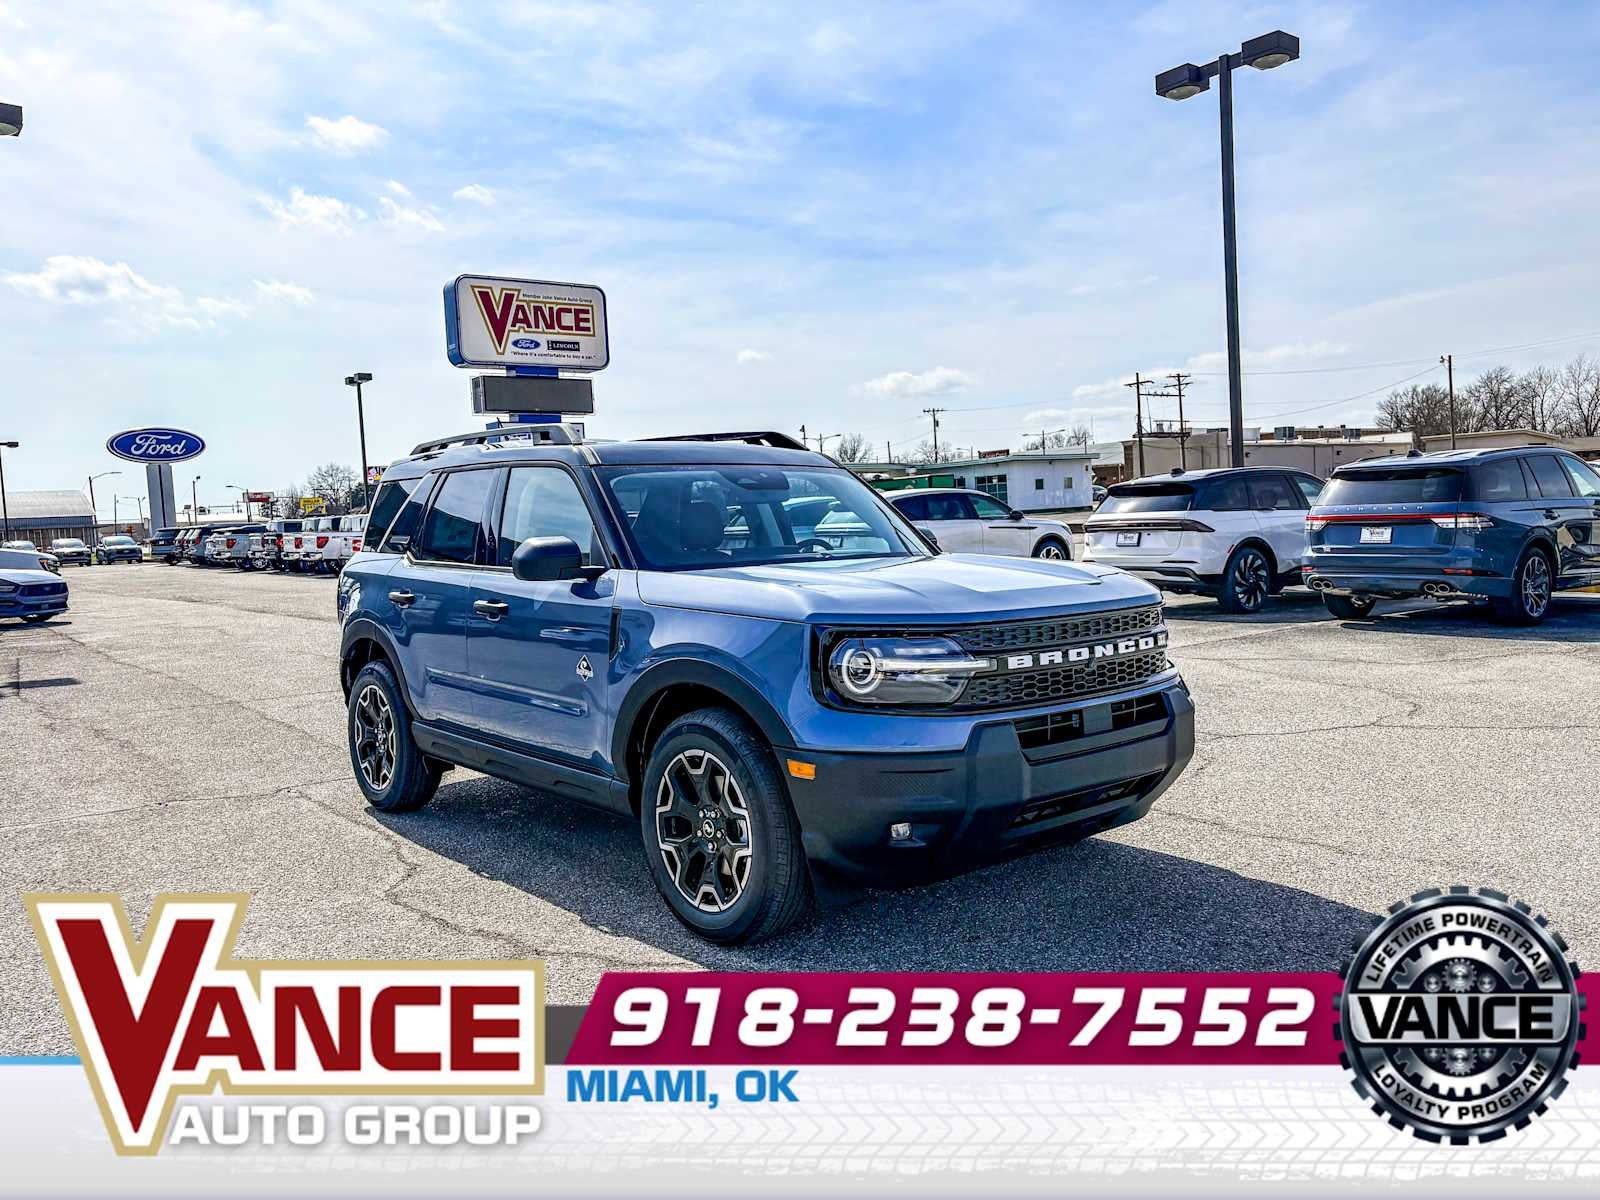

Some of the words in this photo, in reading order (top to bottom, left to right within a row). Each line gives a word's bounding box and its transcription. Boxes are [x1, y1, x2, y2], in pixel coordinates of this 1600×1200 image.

[477, 291, 592, 347] VANCE
[517, 340, 535, 349] Ford
[131, 434, 186, 455] Ford
[1007, 636, 1155, 670] BRONCO
